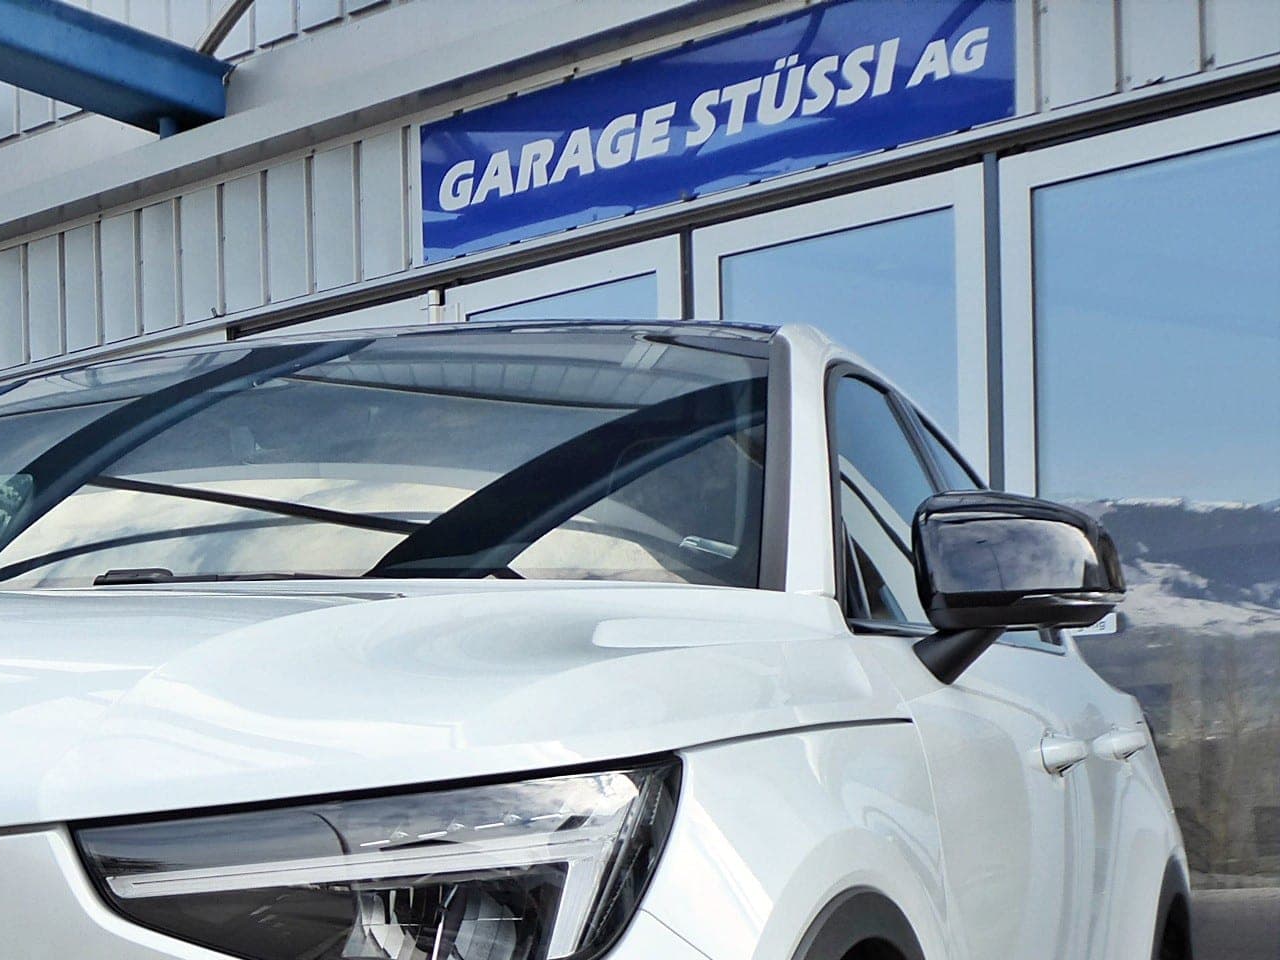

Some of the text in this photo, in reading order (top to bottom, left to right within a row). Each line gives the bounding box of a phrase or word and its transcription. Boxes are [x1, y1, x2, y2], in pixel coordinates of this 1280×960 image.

[438, 27, 989, 212] GARAGE STÜSSI AG
